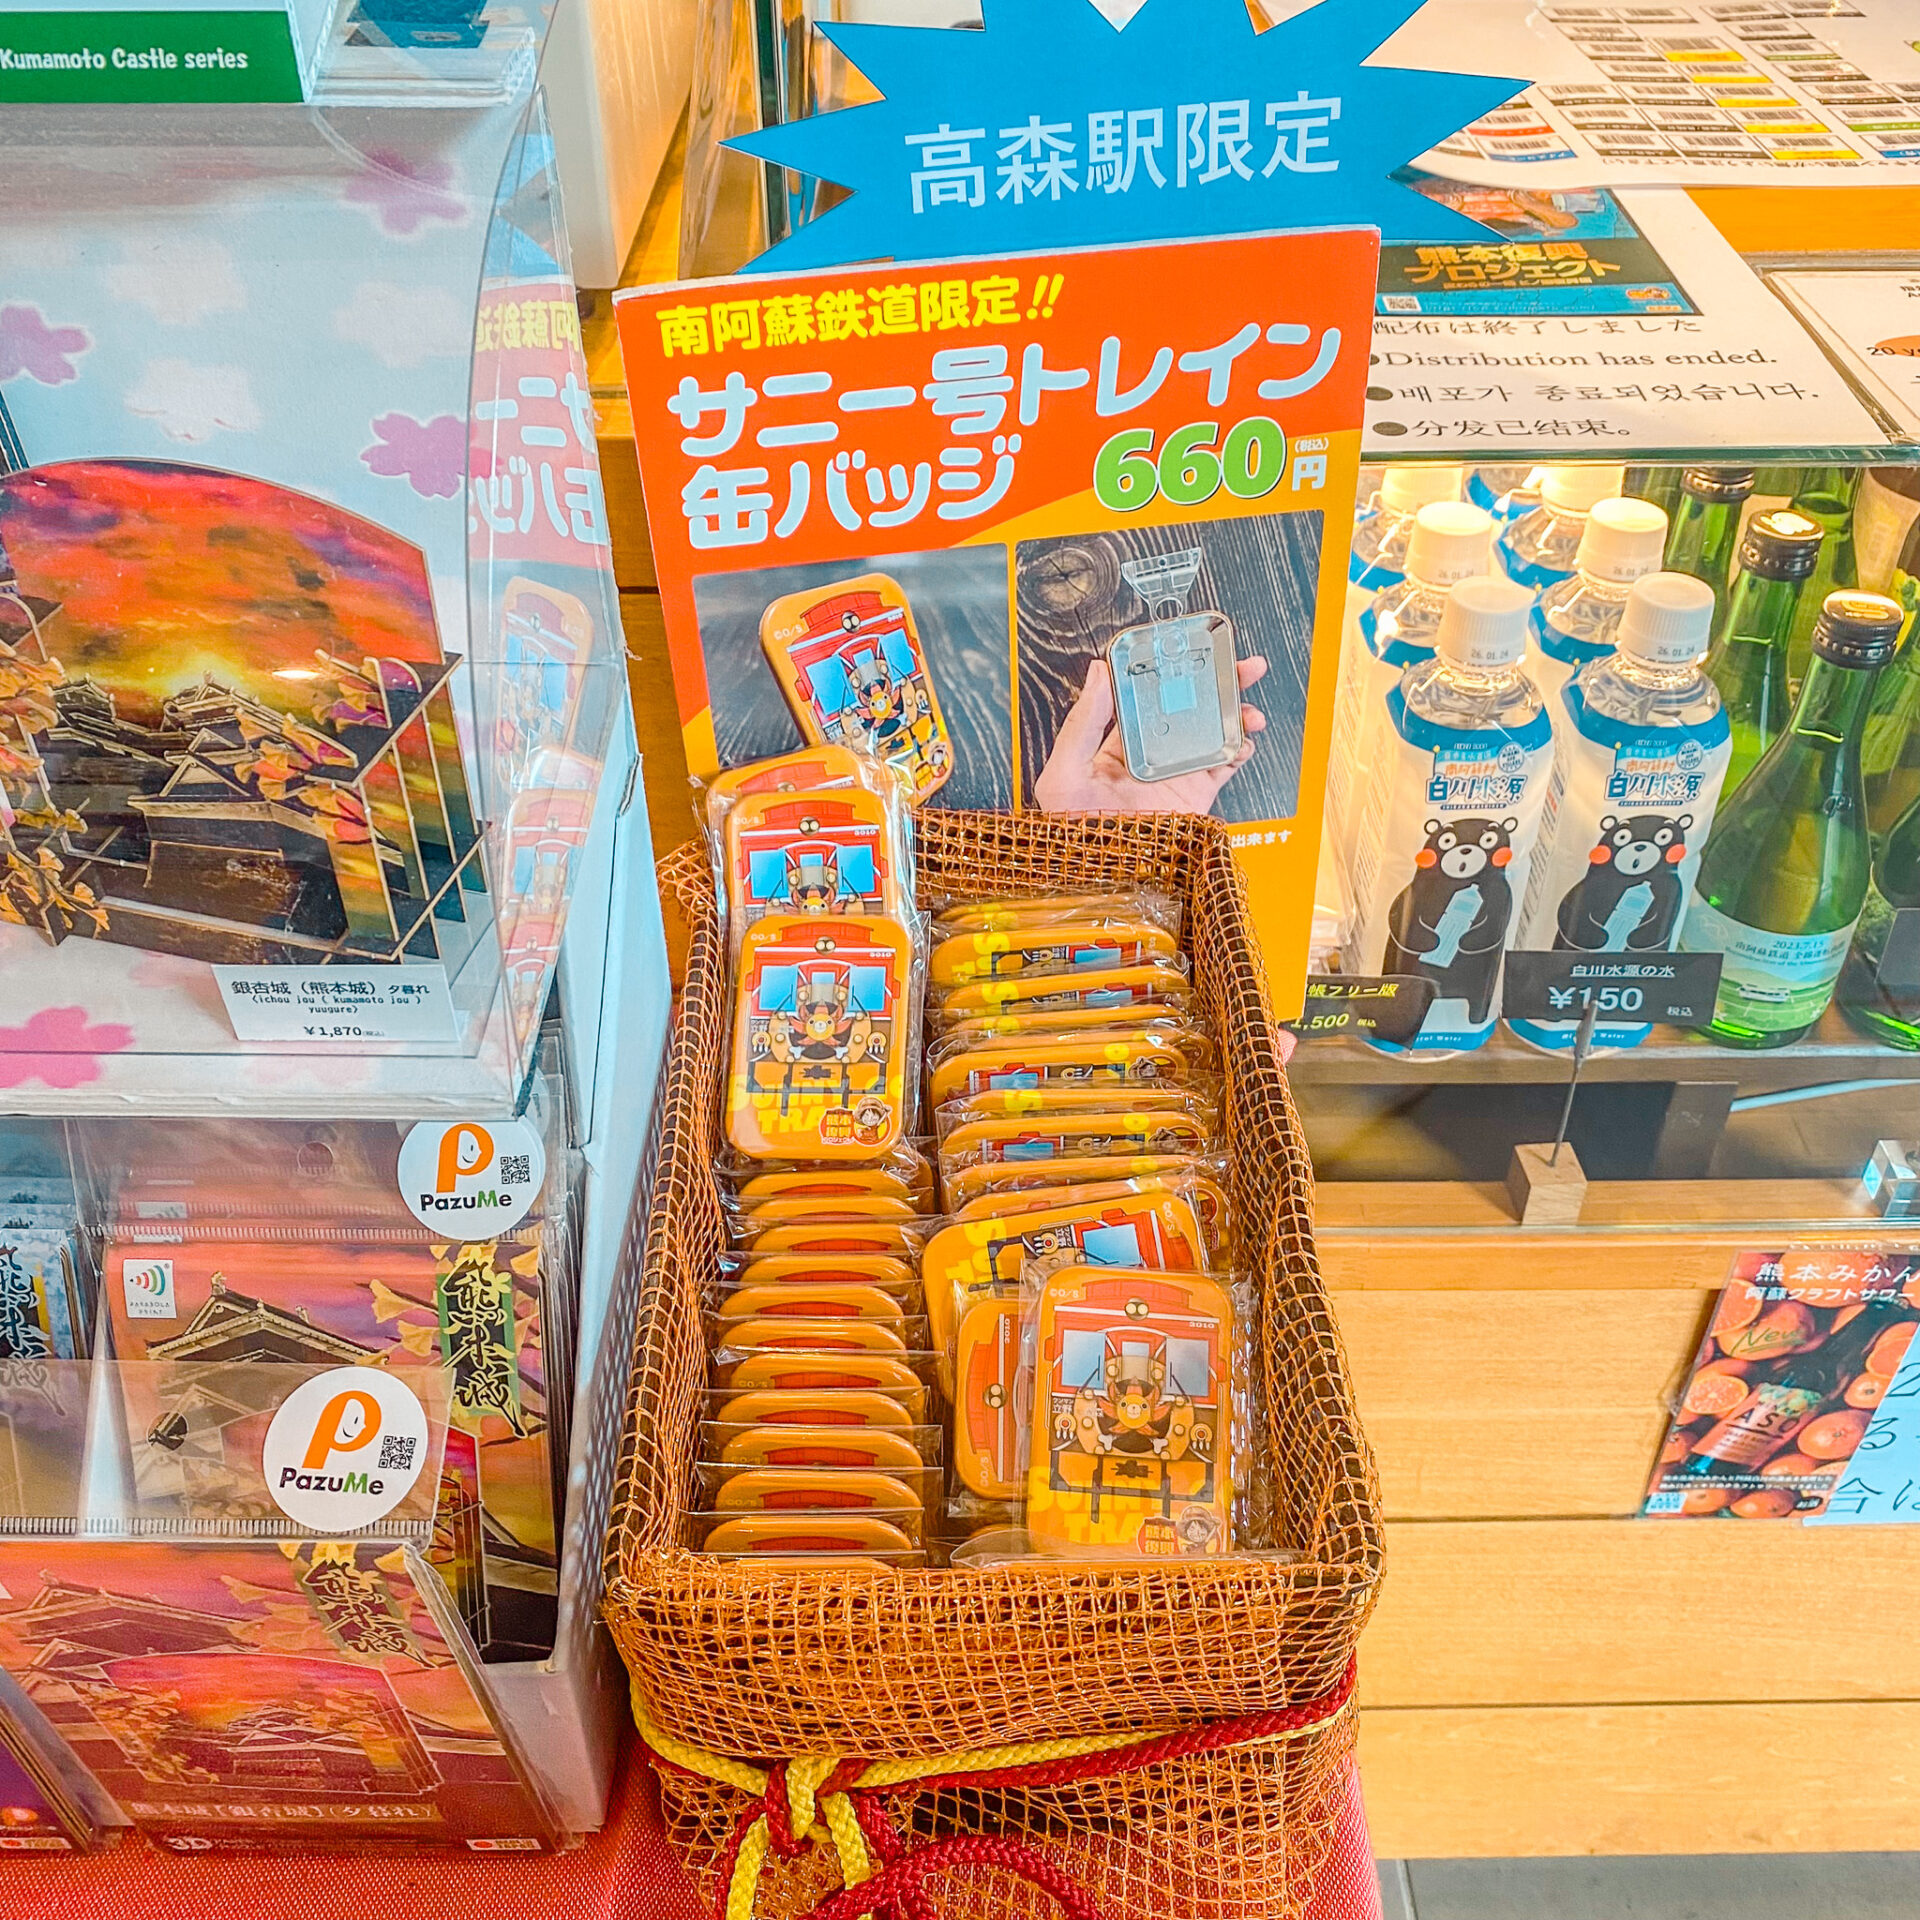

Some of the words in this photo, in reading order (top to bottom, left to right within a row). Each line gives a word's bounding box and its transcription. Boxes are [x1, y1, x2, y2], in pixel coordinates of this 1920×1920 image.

[0, 47, 105, 69] Kumamoto
[112, 47, 177, 68] Castle
[185, 47, 248, 68] series
[904, 91, 1342, 214] 高森駅限定
[1415, 243, 1588, 264] 熊本復興
[1404, 259, 1621, 283] プロジェクト
[656, 273, 1065, 357] 南阿蘇鉄道限定!!
[1374, 320, 1702, 336] 配布は終了しました
[1382, 352, 1589, 367] Distribution
[1599, 352, 1655, 366] has
[1666, 349, 1777, 365] ended.
[668, 323, 1342, 457] サニー号トレイン
[1399, 385, 1512, 403] 배포가
[1535, 382, 1819, 402] 종료되었습니다.
[1412, 419, 1630, 438] 分发已结束。
[1093, 416, 1287, 512] 660
[1292, 454, 1327, 491] 円
[682, 434, 1022, 550] 缶バッジ
[1427, 773, 1527, 804] 白川水源
[1605, 770, 1704, 800] 白川水源
[1231, 829, 1292, 848] 出来ます
[1572, 965, 1676, 976] 白川水源の水
[1307, 983, 1400, 997] 帳フリー版
[1548, 986, 1643, 1011] ¥150
[1667, 1006, 1693, 1017] 税込
[304, 1026, 362, 1038] ¥1,870
[420, 1190, 513, 1211] PazuMe
[1755, 1262, 1920, 1284] 熊本みかん
[1745, 1286, 1916, 1301] 阿蘇クラフトサワー
[1734, 1407, 1800, 1433] ASO
[279, 1467, 385, 1497] PazuMe
